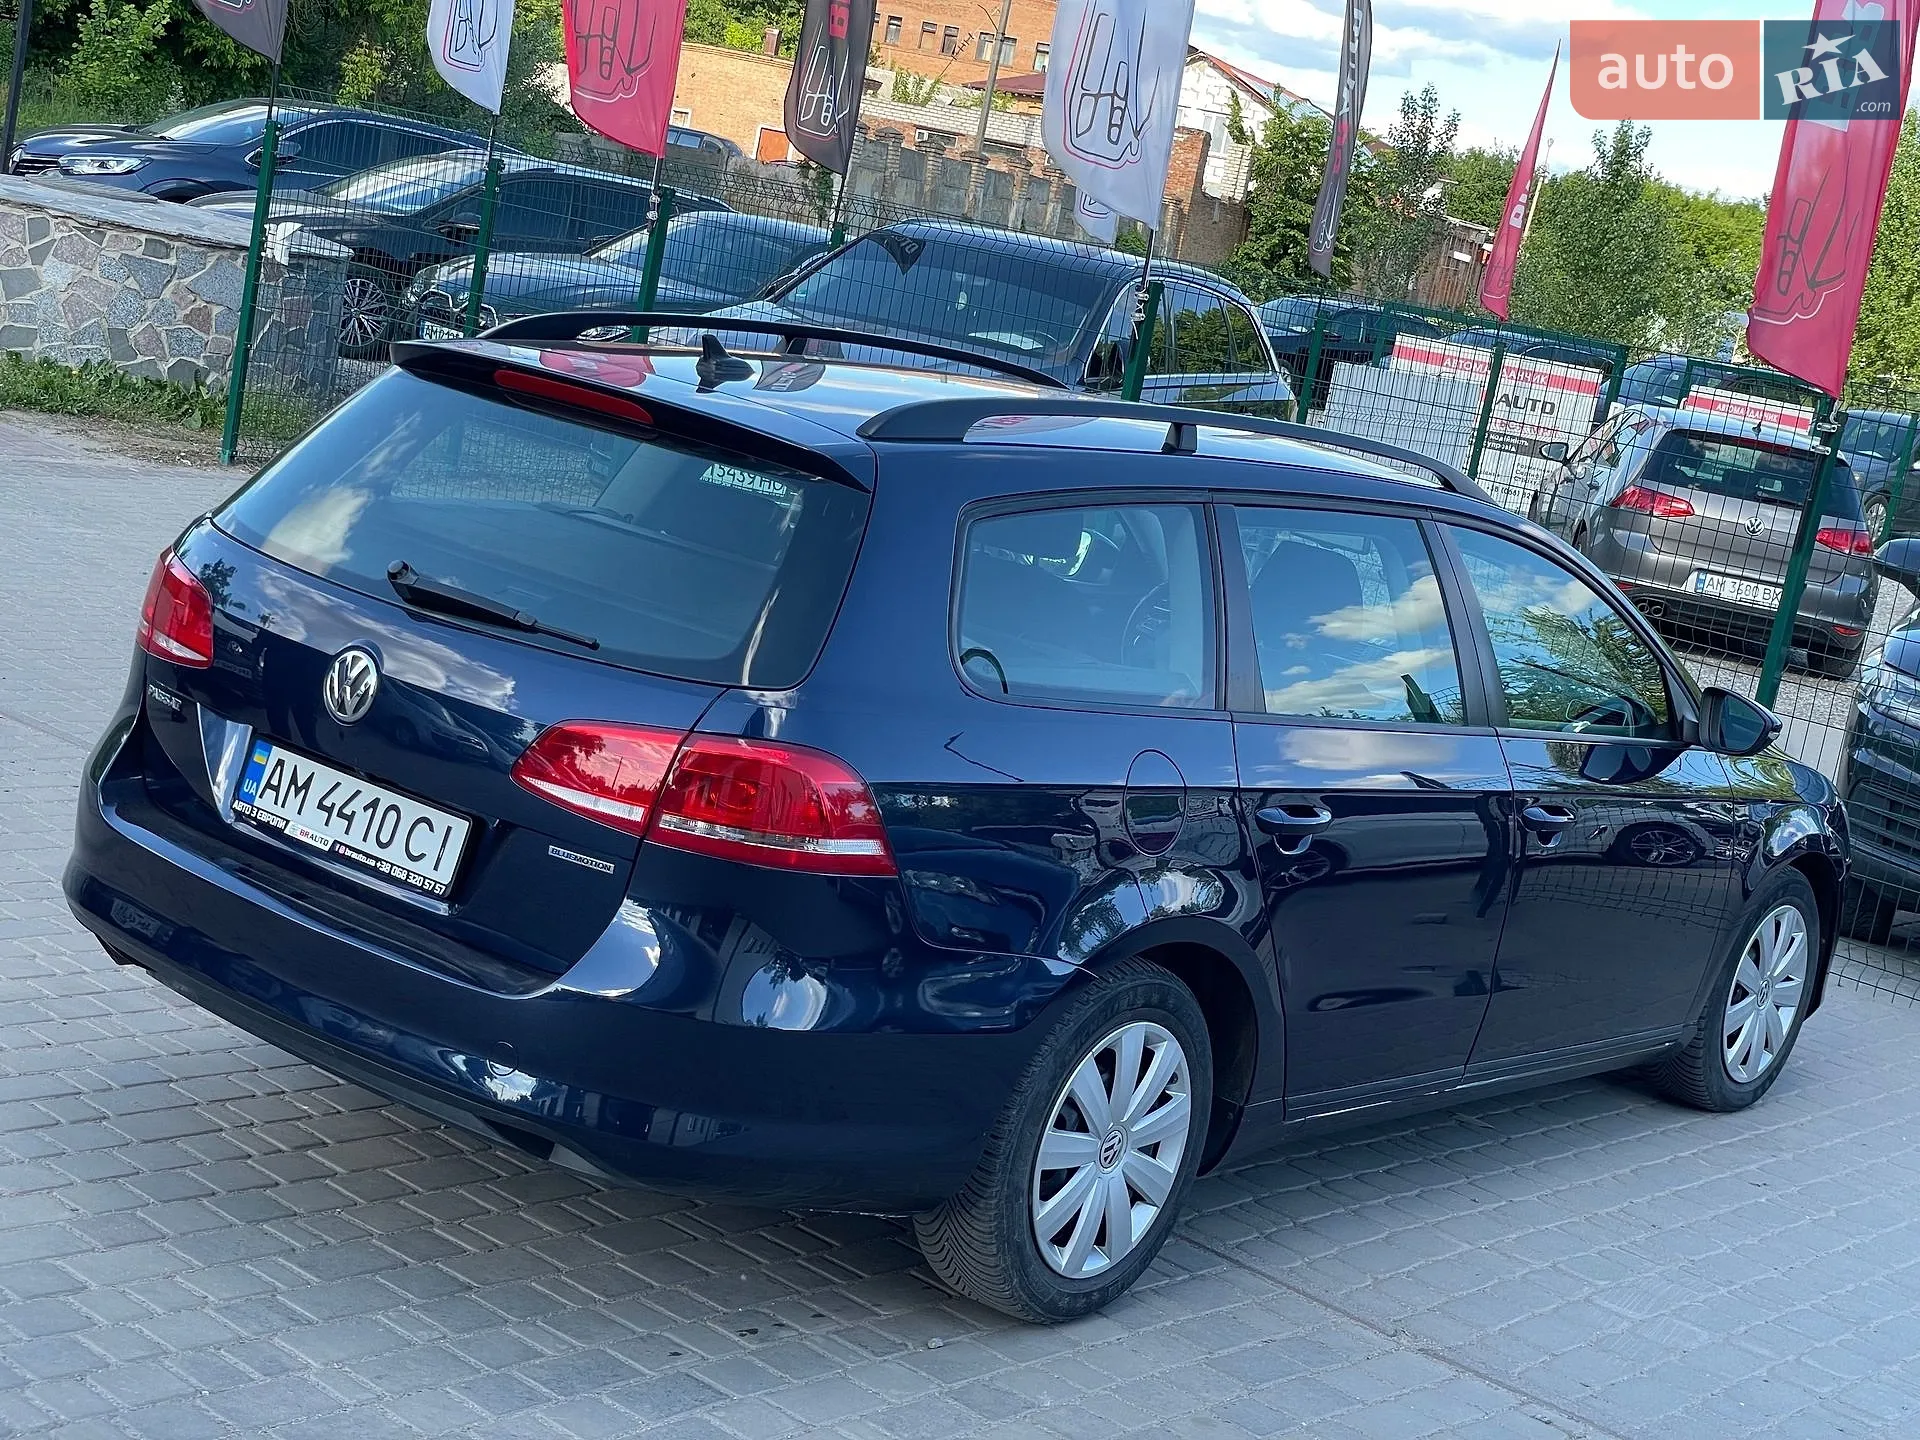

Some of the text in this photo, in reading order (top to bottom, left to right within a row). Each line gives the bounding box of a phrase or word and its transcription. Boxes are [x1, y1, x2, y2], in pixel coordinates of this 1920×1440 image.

[1495, 393, 1556, 415] AUTO
[1705, 577, 1726, 592] AM
[243, 778, 256, 796] UA
[232, 799, 251, 816] АВТО
[259, 758, 452, 871] AM 4410 CI
[299, 828, 330, 847] BRAUTO
[551, 847, 611, 871] BLUEMOTION
[376, 860, 391, 873] +38
[391, 864, 407, 880] 068
[407, 870, 422, 887] 320
[422, 876, 434, 890] 57
[434, 881, 446, 895] 57
